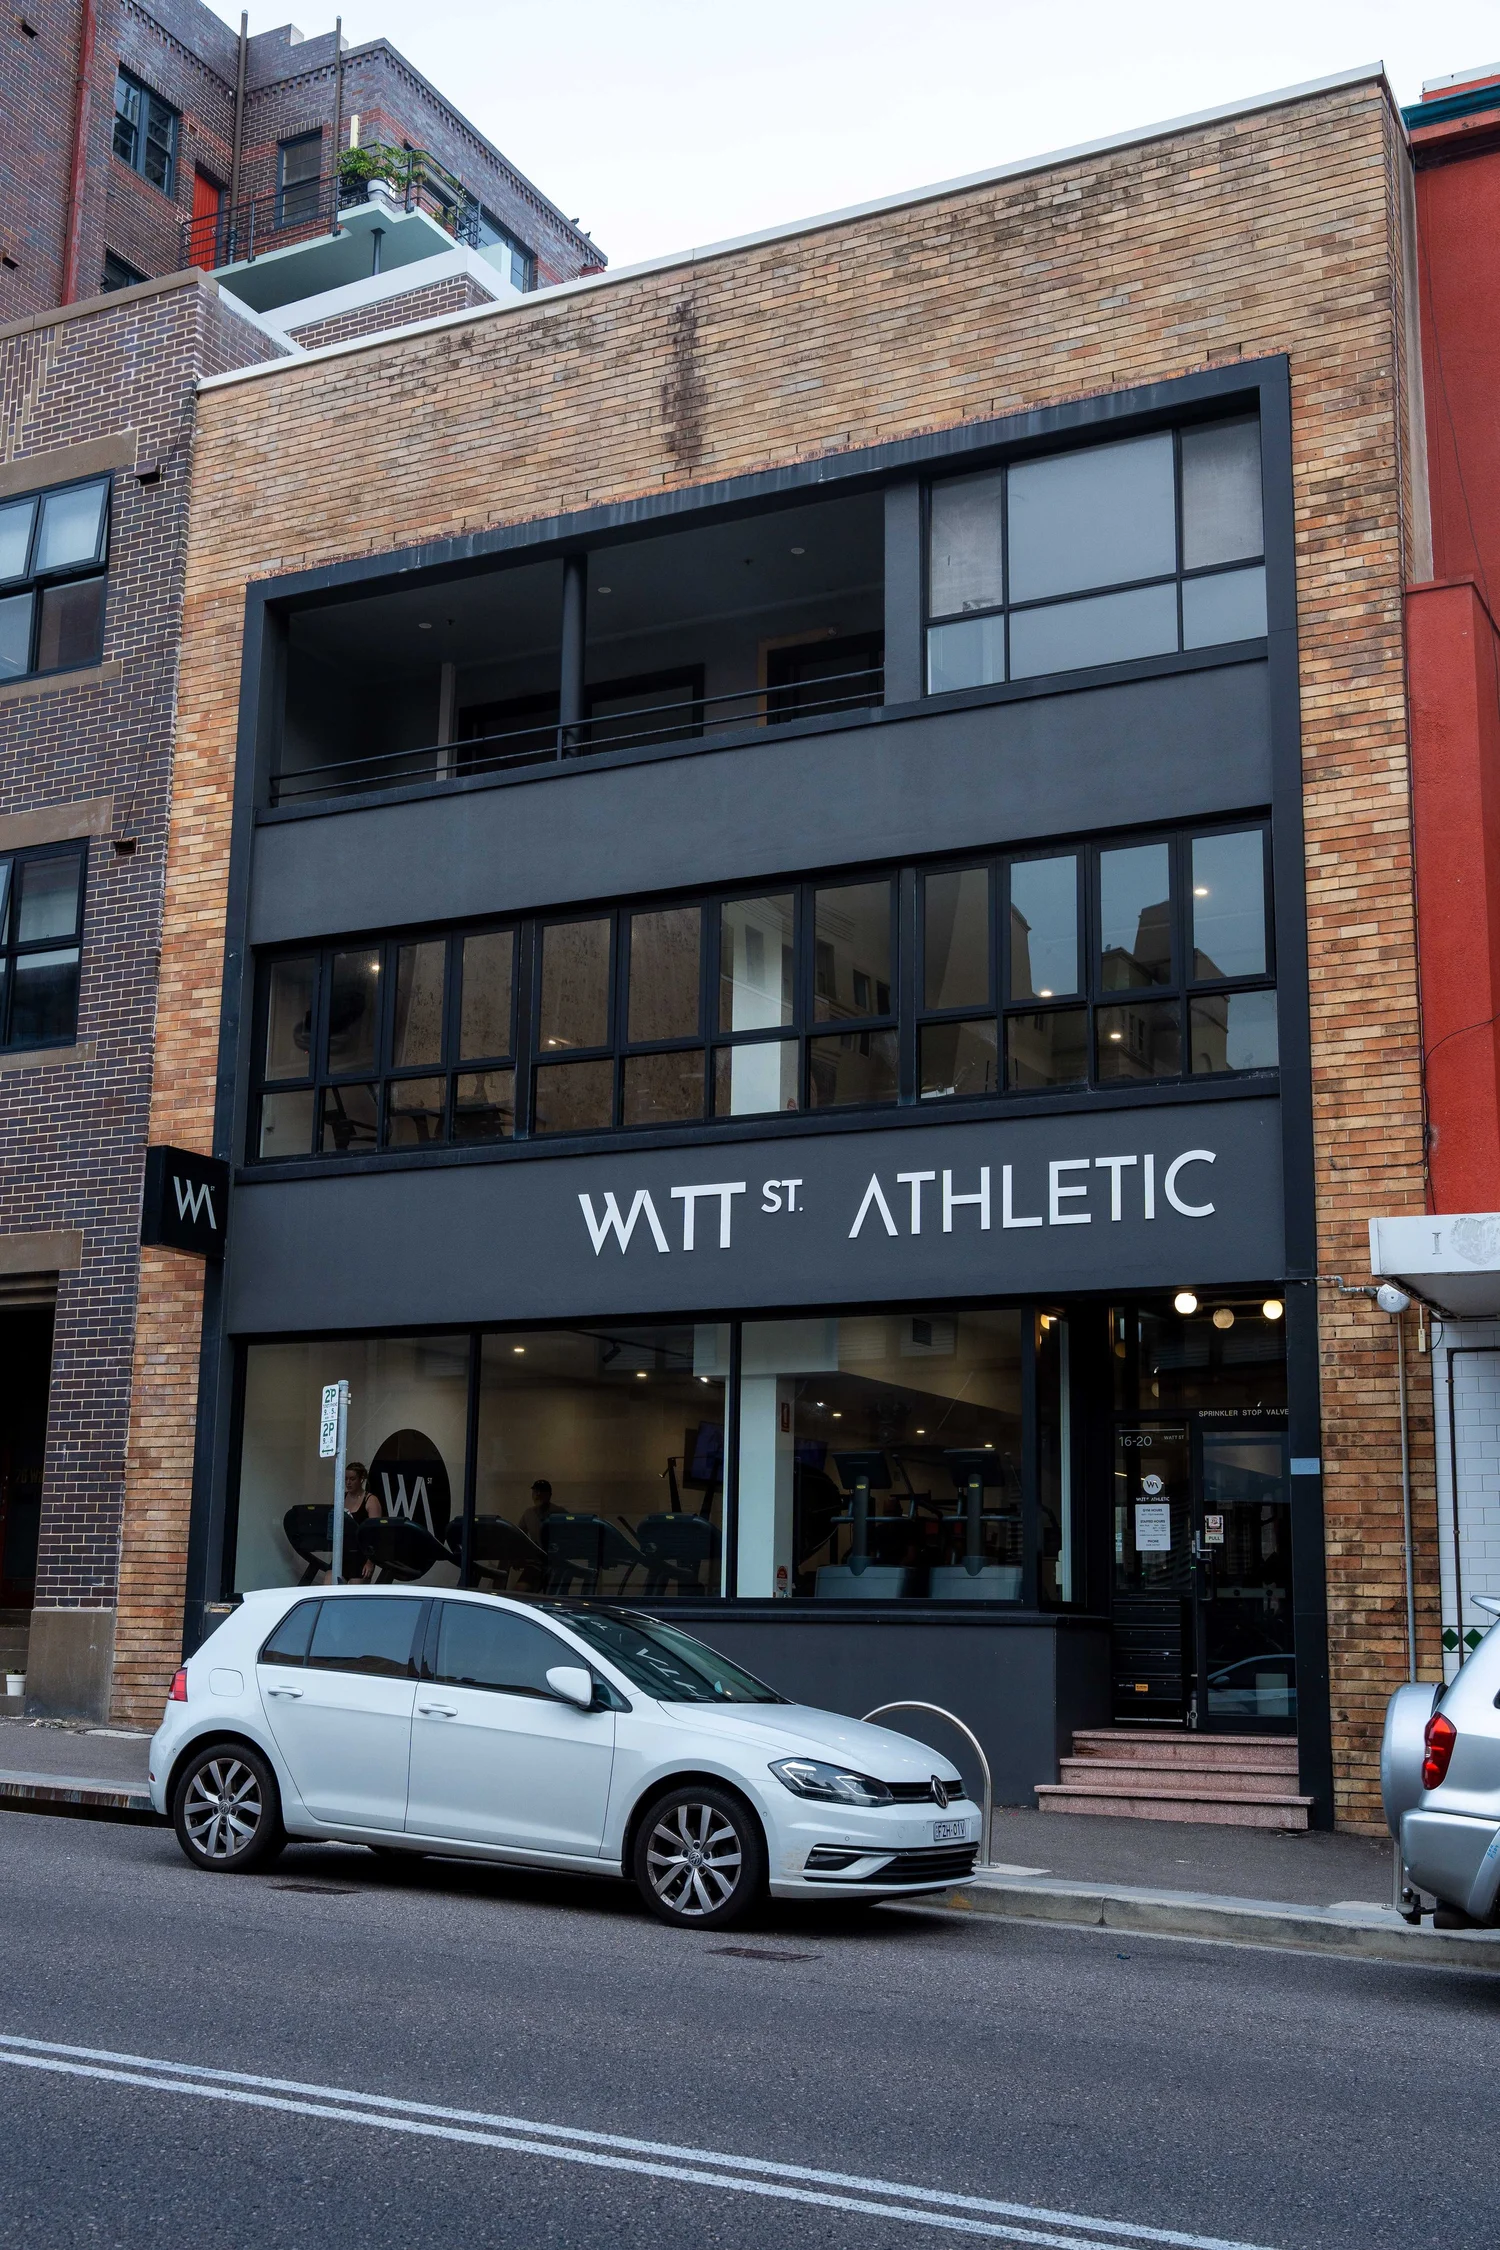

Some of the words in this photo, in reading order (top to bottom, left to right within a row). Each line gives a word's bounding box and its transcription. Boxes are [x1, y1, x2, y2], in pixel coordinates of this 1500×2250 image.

[578, 1182, 746, 1257] WATT
[848, 1149, 1217, 1239] ATHLETIC
[324, 1388, 337, 1404] 2P
[1198, 1410, 1238, 1418] SPRINKLER
[1242, 1409, 1262, 1417] STOP
[1265, 1408, 1289, 1416] VALVE
[322, 1422, 335, 1437] 2P
[1118, 1435, 1153, 1447] 16-20
